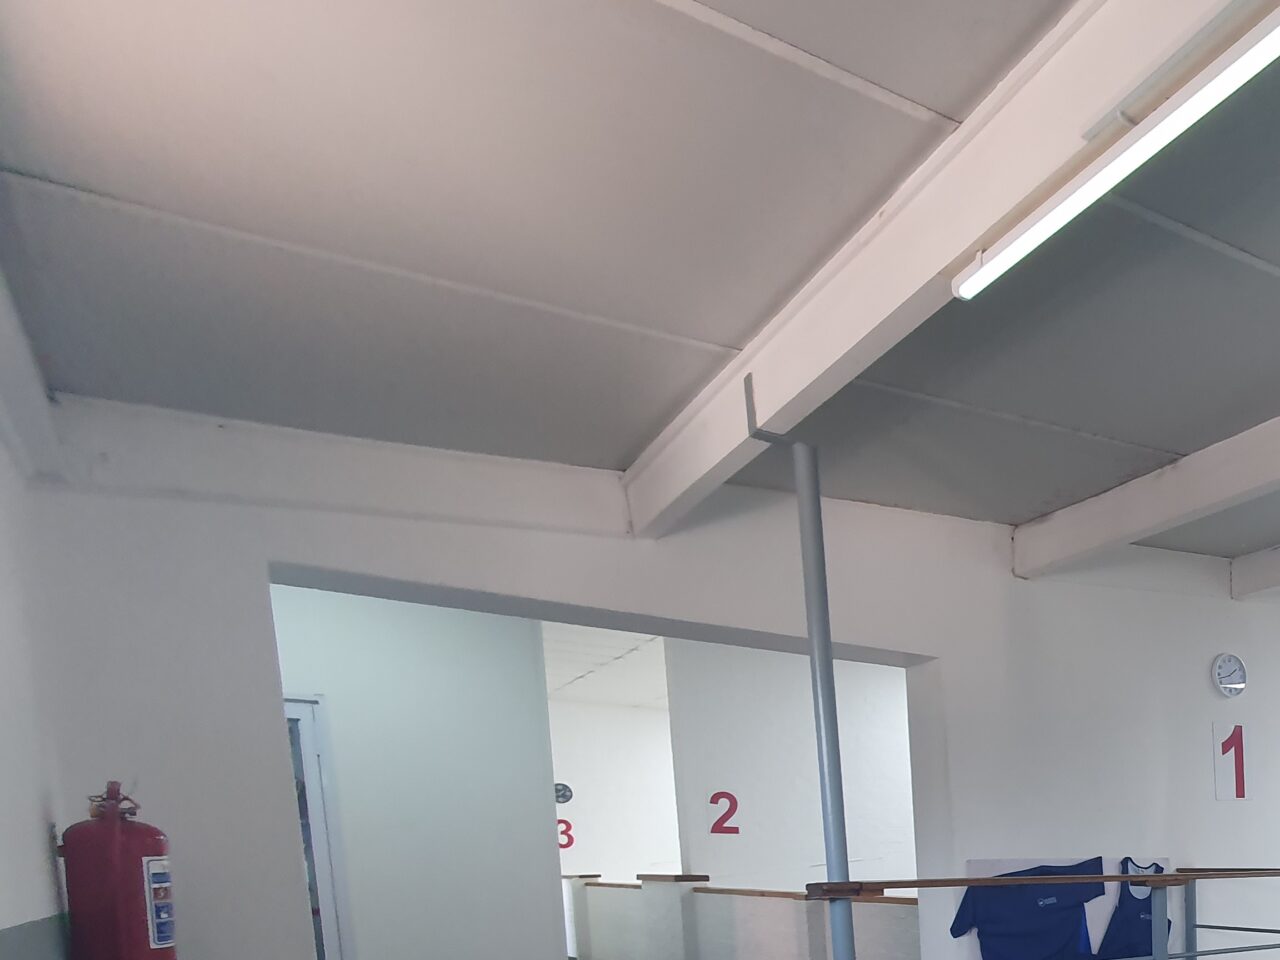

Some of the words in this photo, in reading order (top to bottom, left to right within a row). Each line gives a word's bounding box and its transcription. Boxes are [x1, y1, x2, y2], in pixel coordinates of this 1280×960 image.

[1221, 725, 1245, 798] 1
[557, 819, 575, 849] 3
[709, 791, 740, 834] 2
